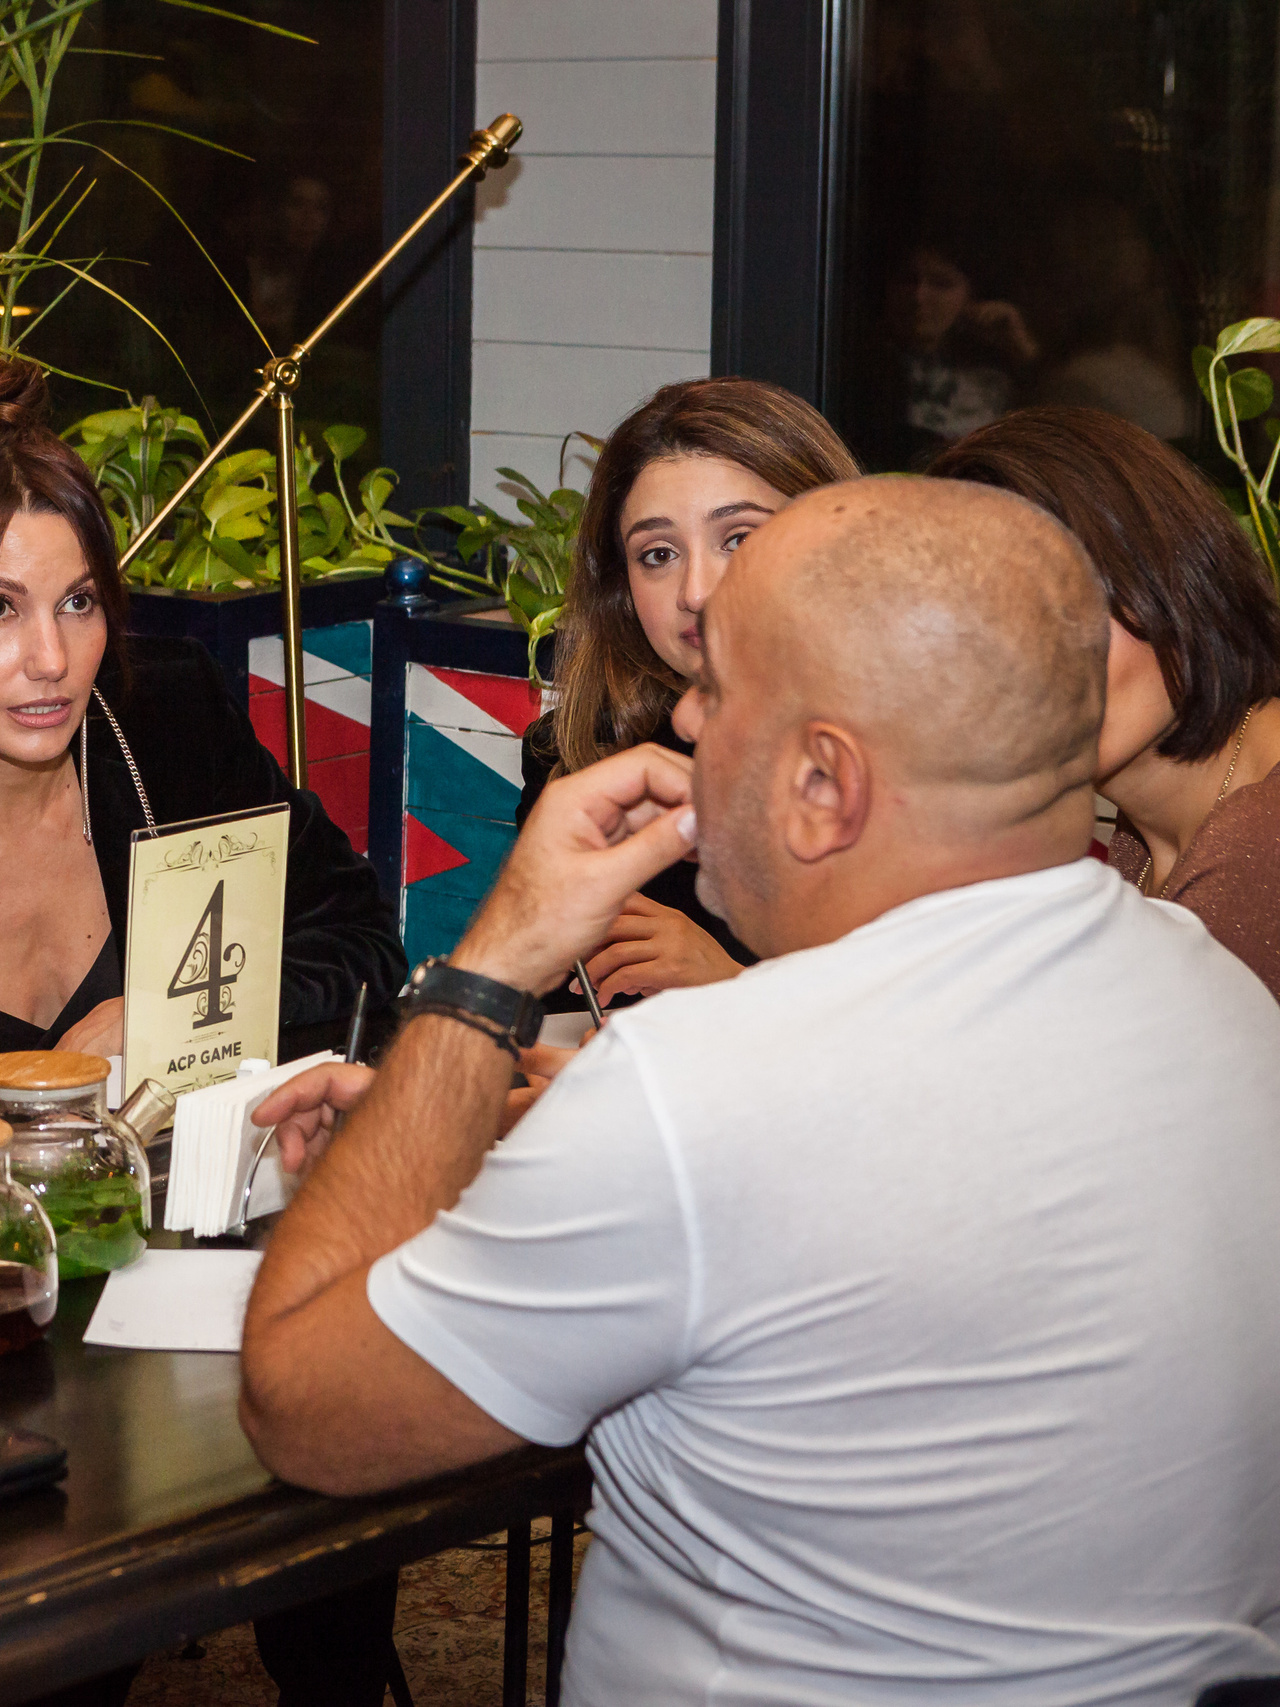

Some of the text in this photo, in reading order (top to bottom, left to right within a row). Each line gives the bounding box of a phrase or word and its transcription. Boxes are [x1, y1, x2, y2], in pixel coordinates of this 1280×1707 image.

[166, 879, 246, 1030] 4
[166, 1041, 242, 1075] ACP GAME
